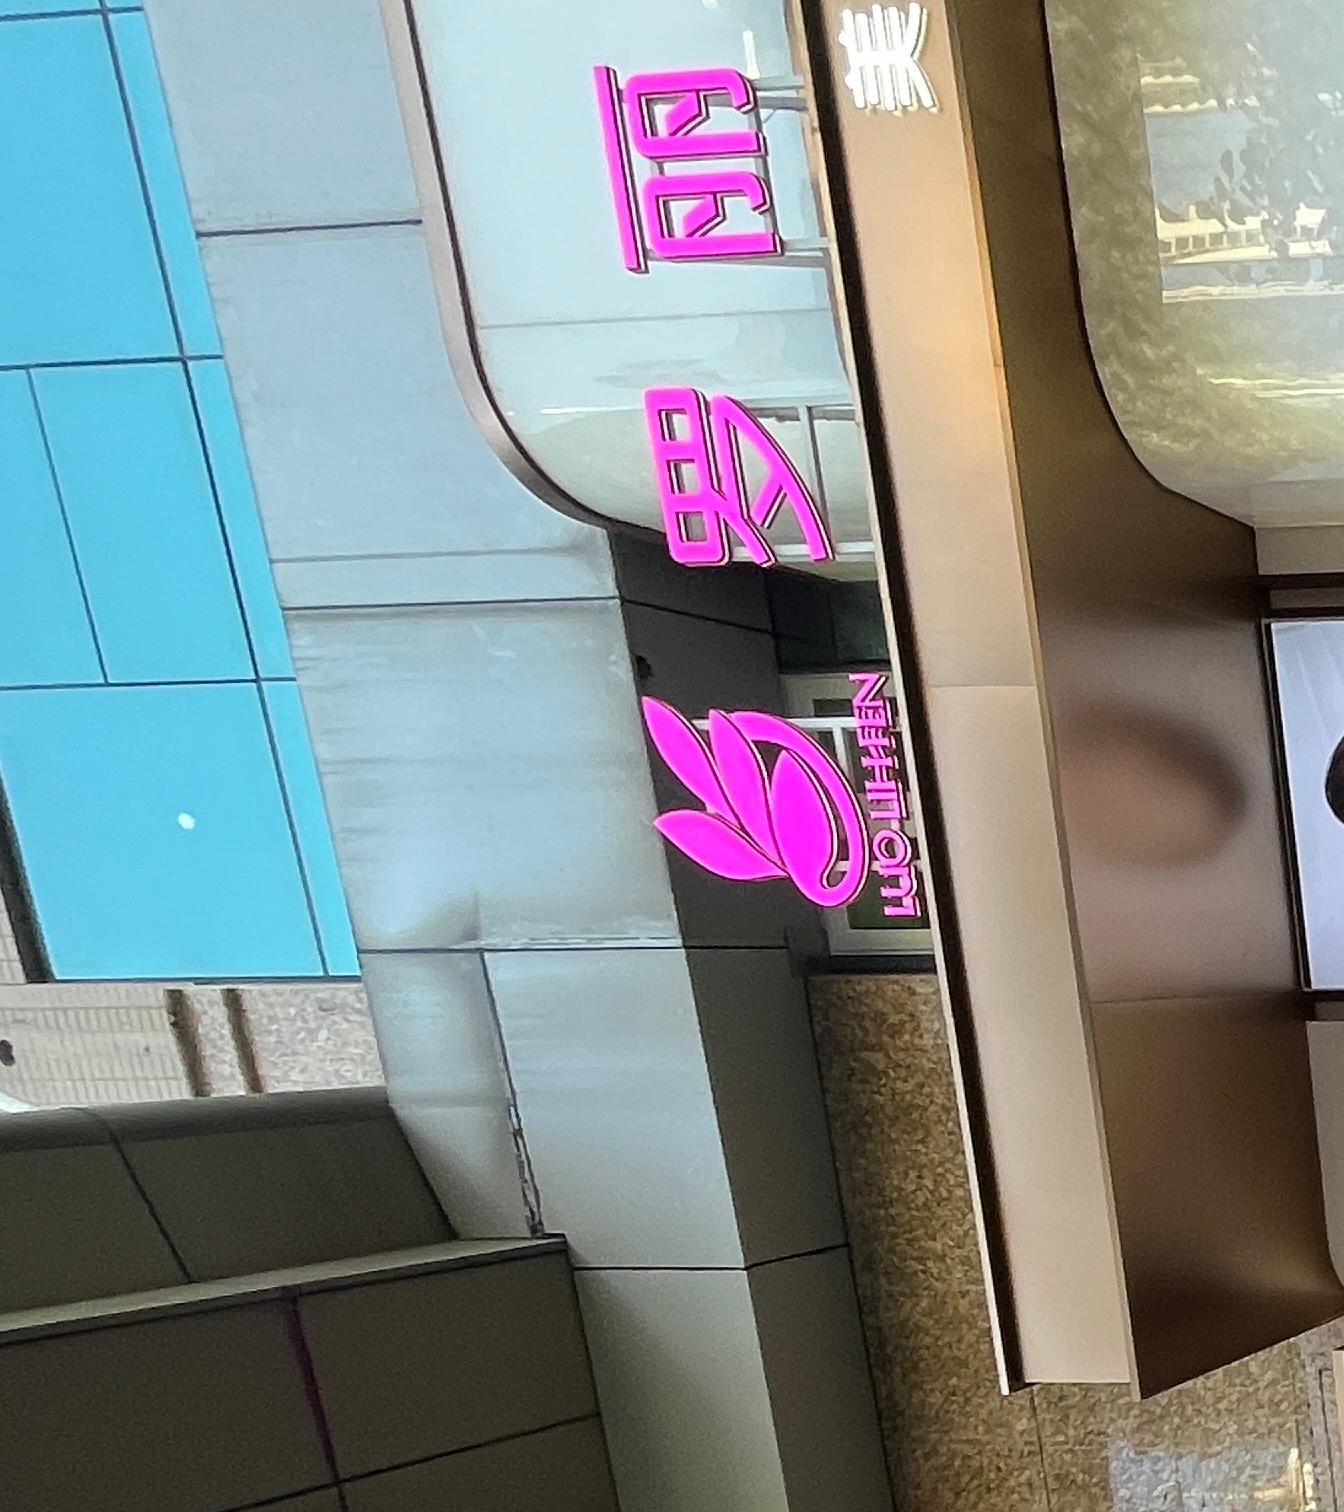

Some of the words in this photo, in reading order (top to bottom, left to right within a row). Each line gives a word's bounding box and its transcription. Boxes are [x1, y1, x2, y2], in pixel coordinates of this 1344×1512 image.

[838, 1, 940, 114] 美
[592, 65, 833, 567] 罗丽
[872, 828, 921, 918] LUO
